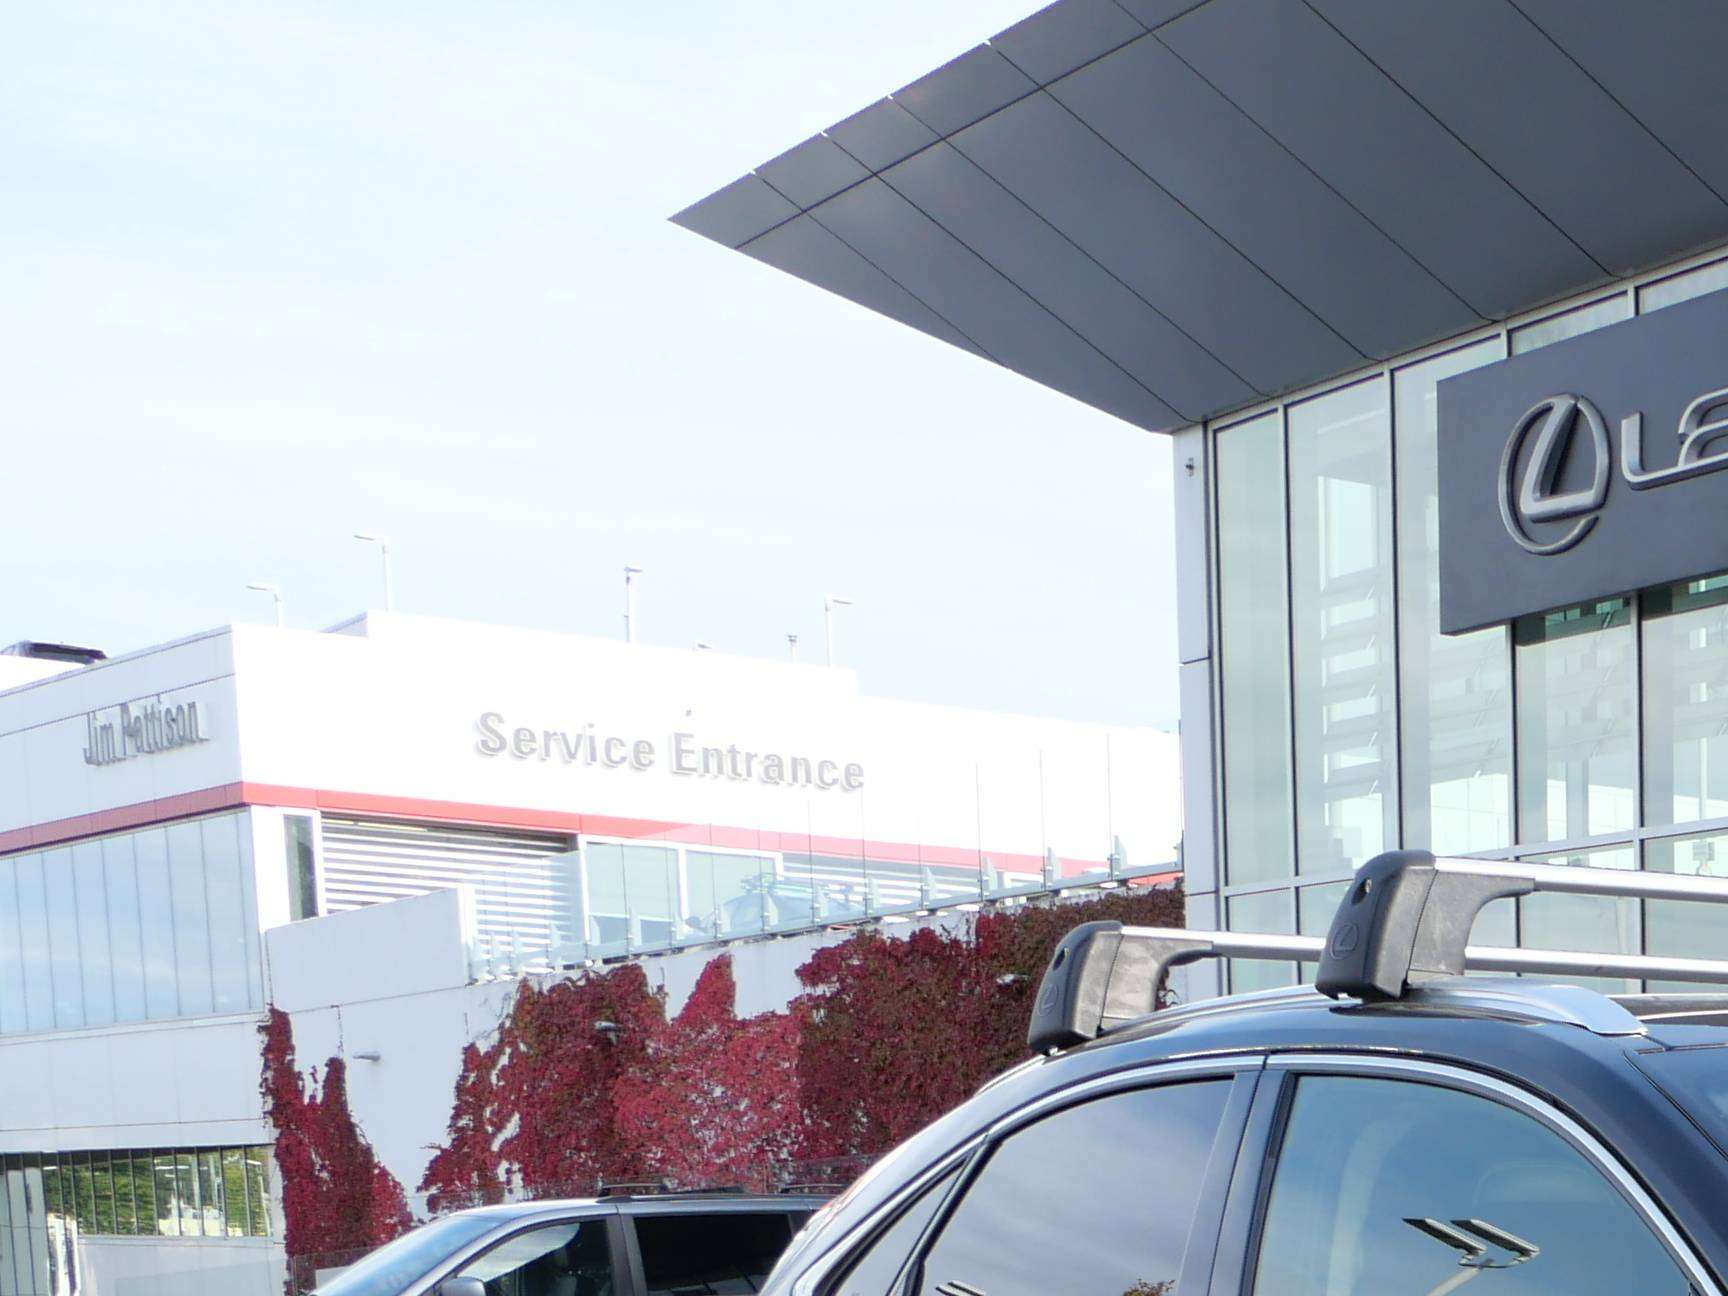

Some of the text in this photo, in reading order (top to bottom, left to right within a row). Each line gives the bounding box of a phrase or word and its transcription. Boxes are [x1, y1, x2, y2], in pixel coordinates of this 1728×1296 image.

[83, 694, 209, 766] Jim Pattison
[475, 711, 866, 792] Service Entrance
